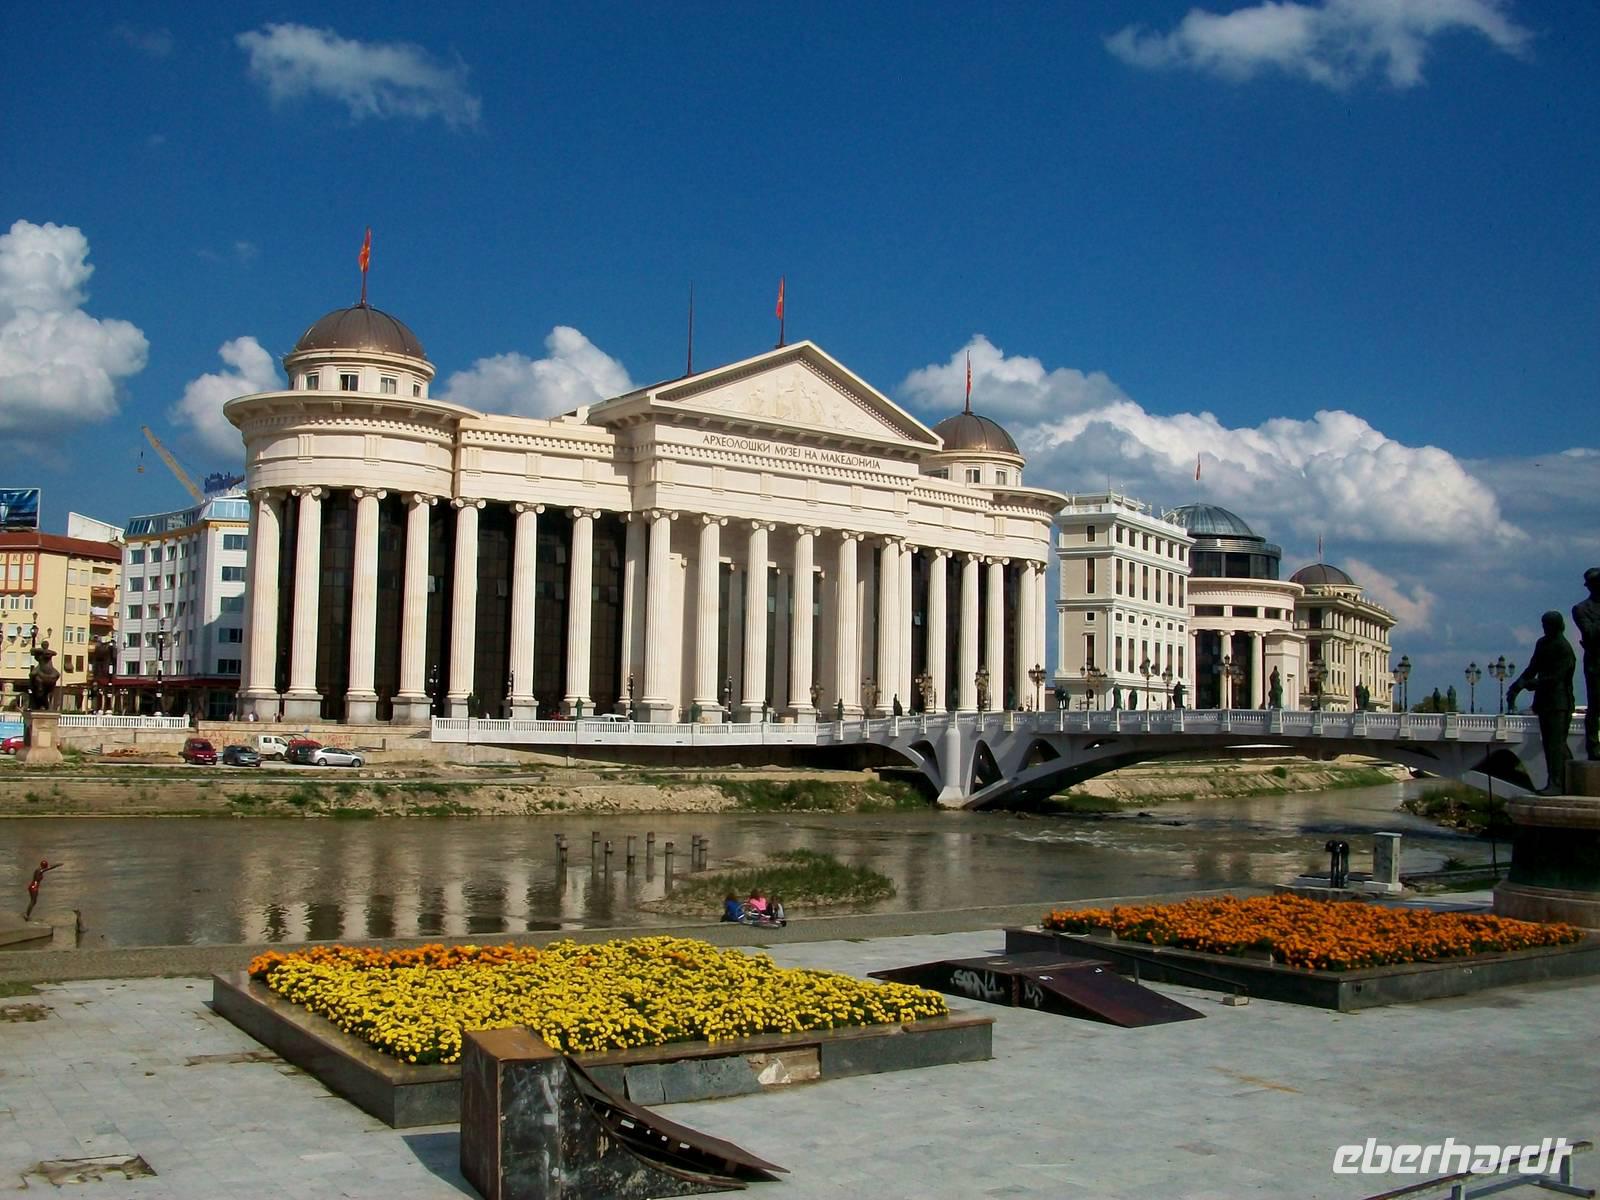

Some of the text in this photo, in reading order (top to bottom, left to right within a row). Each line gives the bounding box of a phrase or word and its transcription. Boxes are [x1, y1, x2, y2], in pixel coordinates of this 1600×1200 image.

[702, 434, 881, 470] АРХЕОЛОШКИ МУЗЕЈ НА МАКЕДОНИЈА
